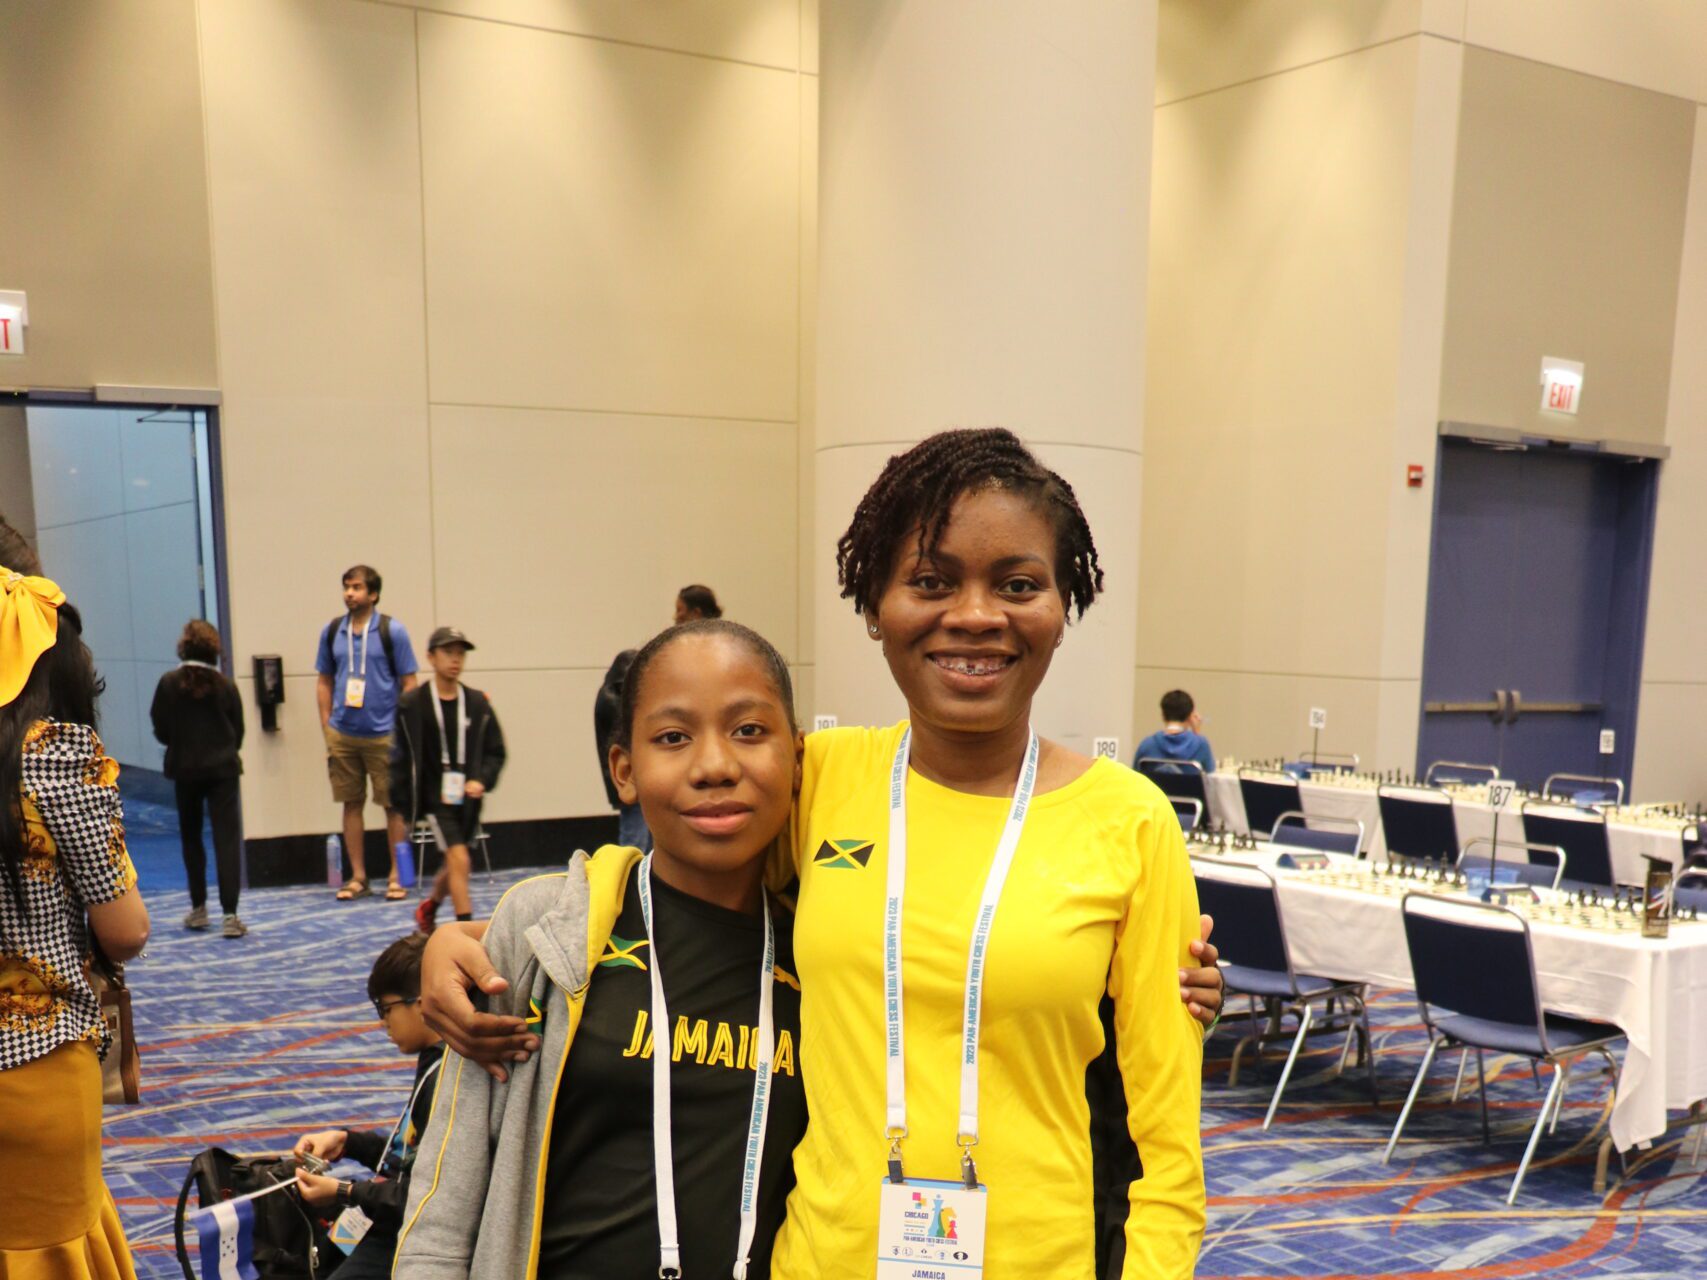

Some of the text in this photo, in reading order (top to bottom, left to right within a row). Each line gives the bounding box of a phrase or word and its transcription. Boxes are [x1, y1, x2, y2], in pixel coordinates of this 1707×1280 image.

[1549, 382, 1575, 410] EXIT
[1097, 741, 1116, 758] 189
[1488, 785, 1512, 806] 187
[887, 897, 899, 1057] 2023 PAN-AMERICAN YOUTH CHESS FESTIVAL
[966, 904, 993, 1065] 2023 PAN-AMERICAN YOUTH CHESS FESTIVAL
[742, 1061, 769, 1212] 2023 PAN-AMERICAN YOUTH CHESS FESTIVAL
[904, 1211, 929, 1219] CHICAGO
[912, 1269, 945, 1280] JAMAICA
